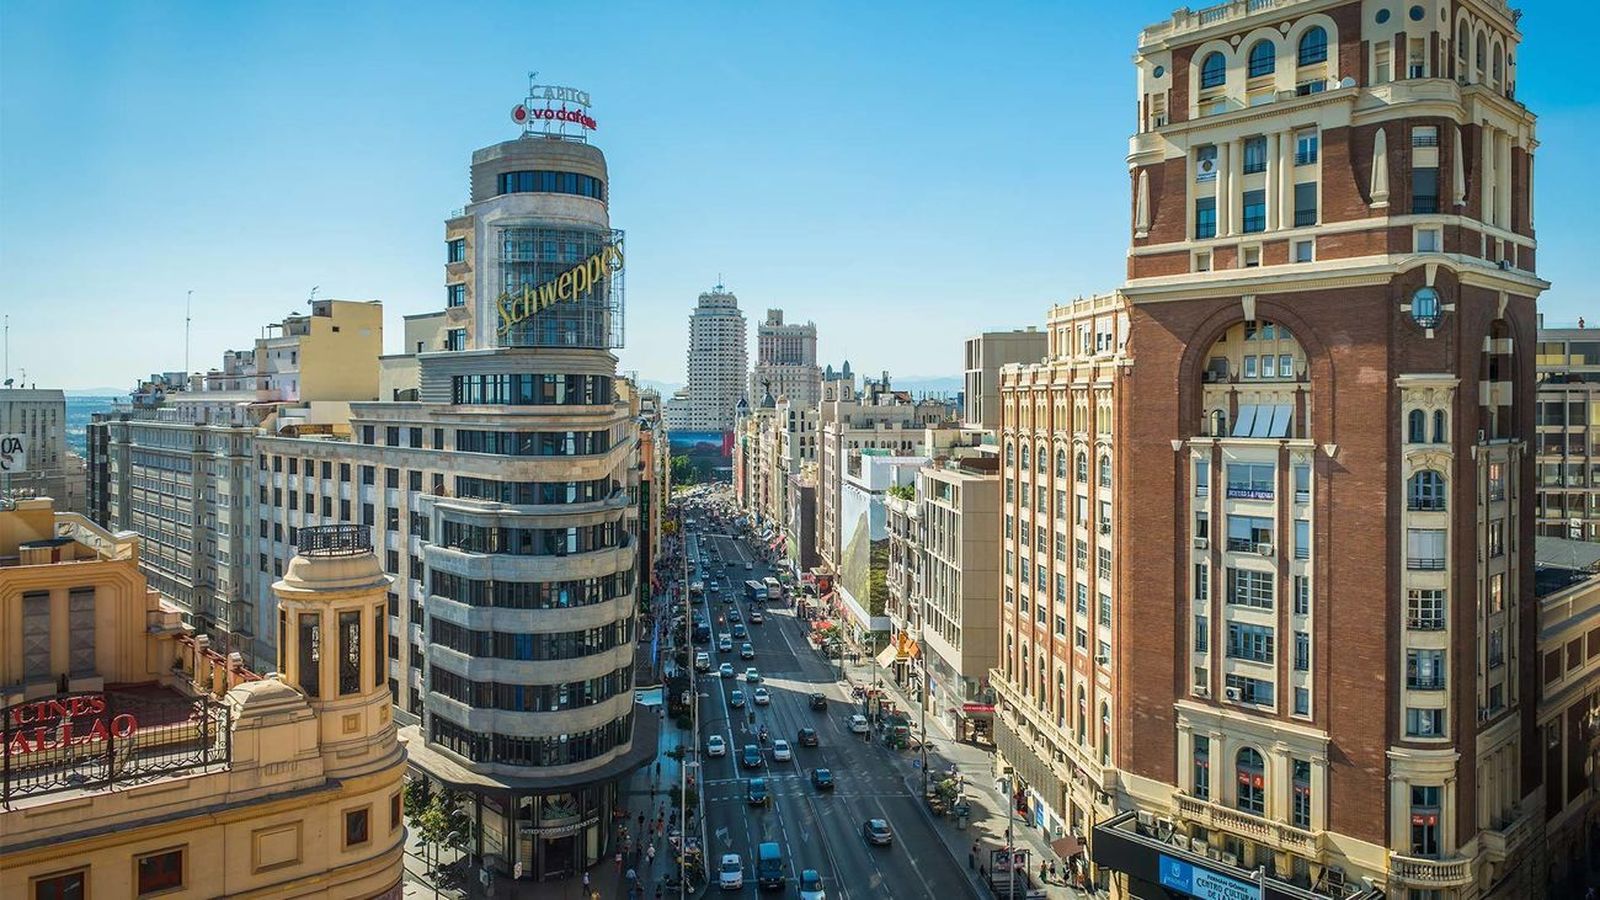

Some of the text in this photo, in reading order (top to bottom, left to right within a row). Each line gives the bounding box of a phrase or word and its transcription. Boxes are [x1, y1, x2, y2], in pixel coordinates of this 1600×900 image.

[531, 85, 591, 108] CAPITOL
[533, 106, 596, 130] vodafone
[496, 240, 624, 336] Schweppes
[11, 695, 107, 725] CINES
[0, 713, 138, 756] ALLAO
[1196, 877, 1223, 893] CENTRO
